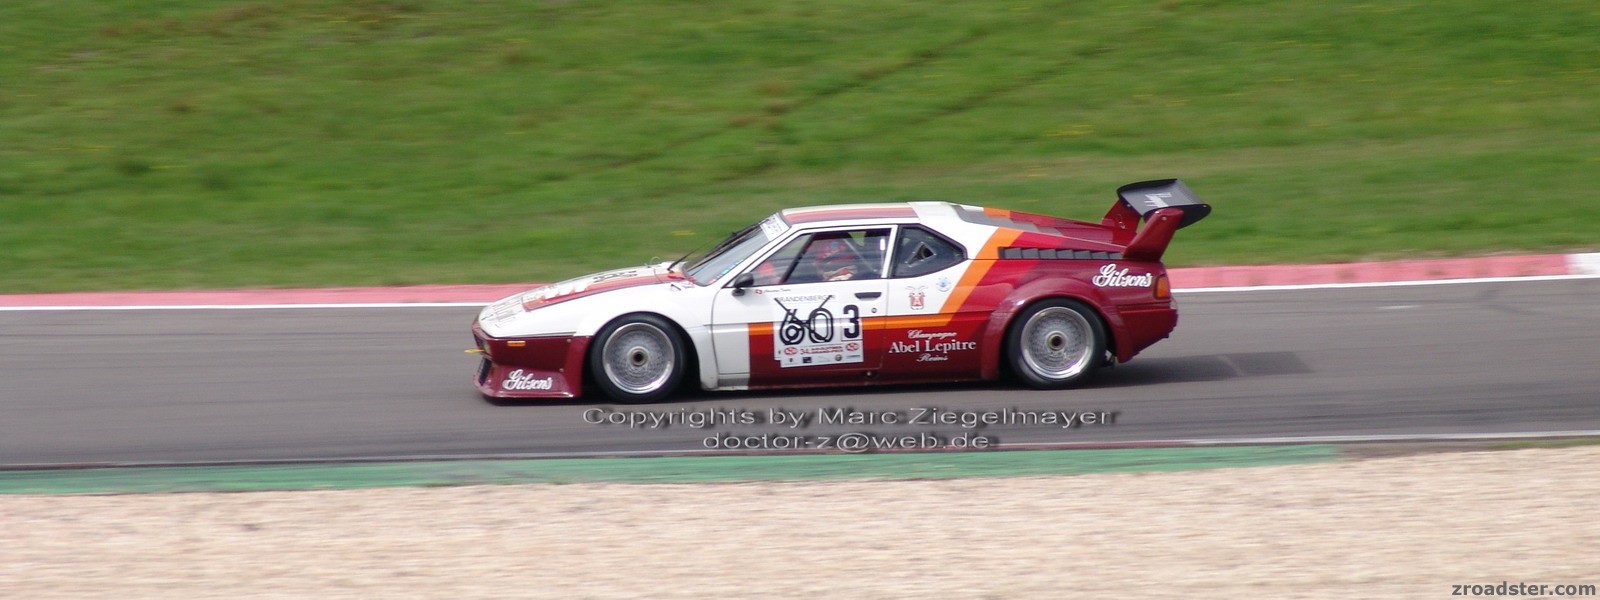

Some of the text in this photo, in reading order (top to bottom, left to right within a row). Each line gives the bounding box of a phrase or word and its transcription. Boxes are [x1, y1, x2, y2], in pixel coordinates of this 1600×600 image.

[1092, 263, 1153, 287] Gibson's
[775, 294, 836, 303] RANDENBERGR
[907, 329, 957, 340] Champagne
[888, 339, 977, 354] Abel Lepitre
[502, 368, 553, 391] Gibson's
